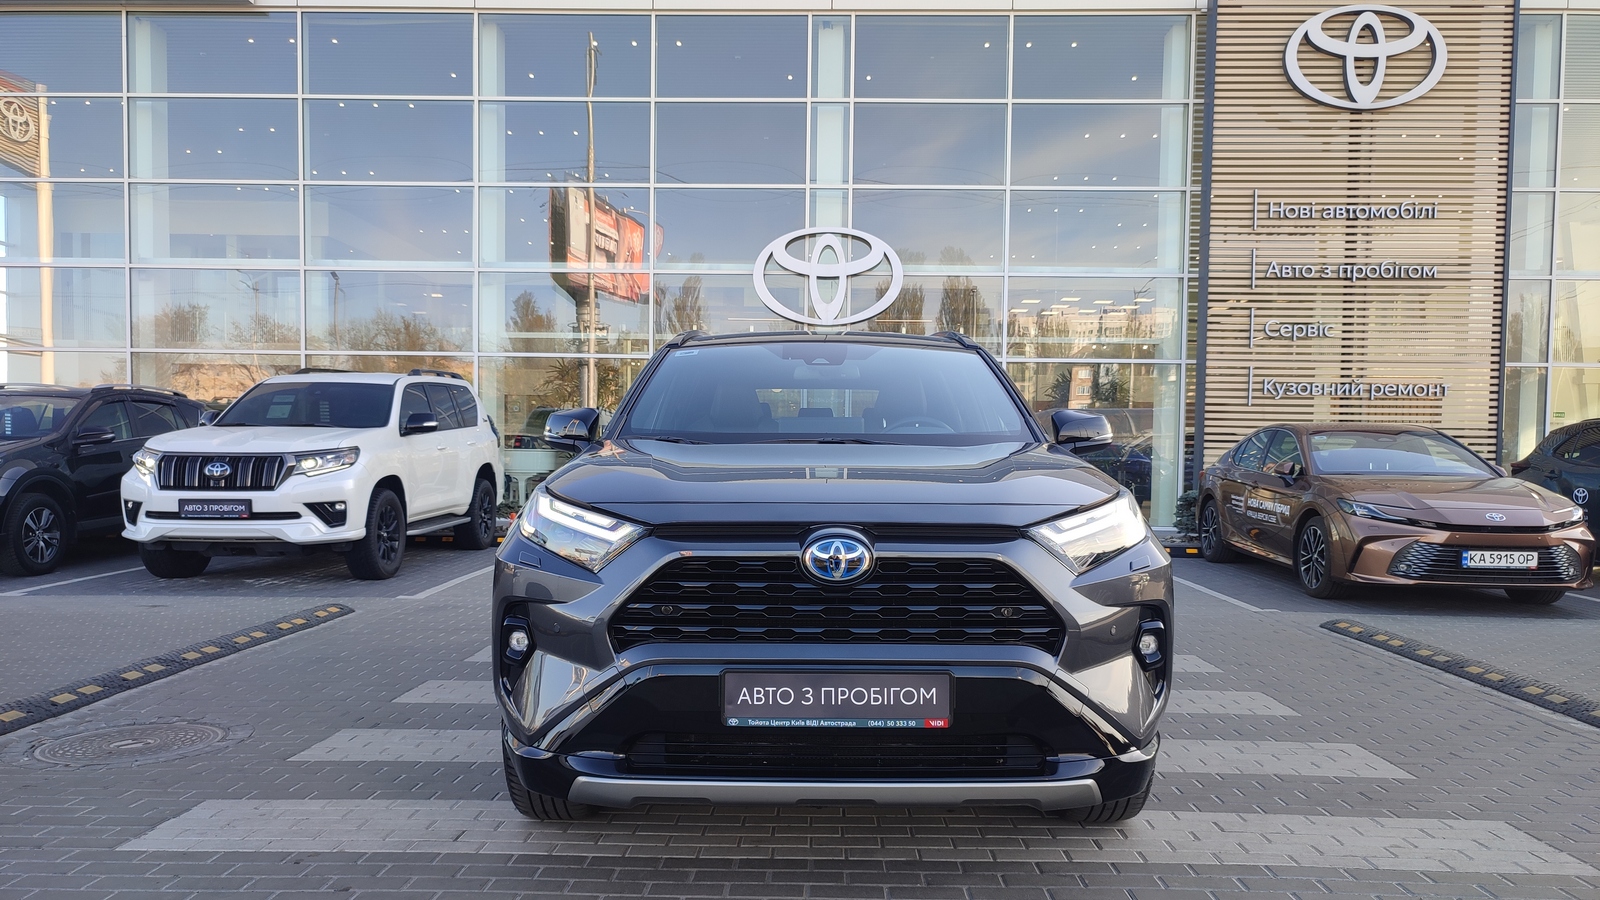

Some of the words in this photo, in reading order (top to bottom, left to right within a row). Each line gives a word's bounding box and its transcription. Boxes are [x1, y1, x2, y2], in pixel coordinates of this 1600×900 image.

[1268, 201, 1316, 219] Нові
[1322, 201, 1438, 219] автомобілі
[1265, 261, 1315, 279] Авто
[1320, 267, 1331, 279] з
[1338, 260, 1438, 282] пробігом
[1264, 319, 1335, 341] Сервіс
[1262, 378, 1363, 399] Кузовний
[1370, 383, 1451, 400] ремонт
[184, 504, 202, 512] АВТО
[209, 504, 245, 512] ПРОБІГОМ
[1489, 553, 1515, 564] 5915
[737, 687, 794, 705] АВТО
[821, 687, 937, 705] ПРОБІГОМ
[770, 719, 790, 727] Центр
[820, 719, 857, 728] Автострада
[868, 720, 885, 728] (044)
